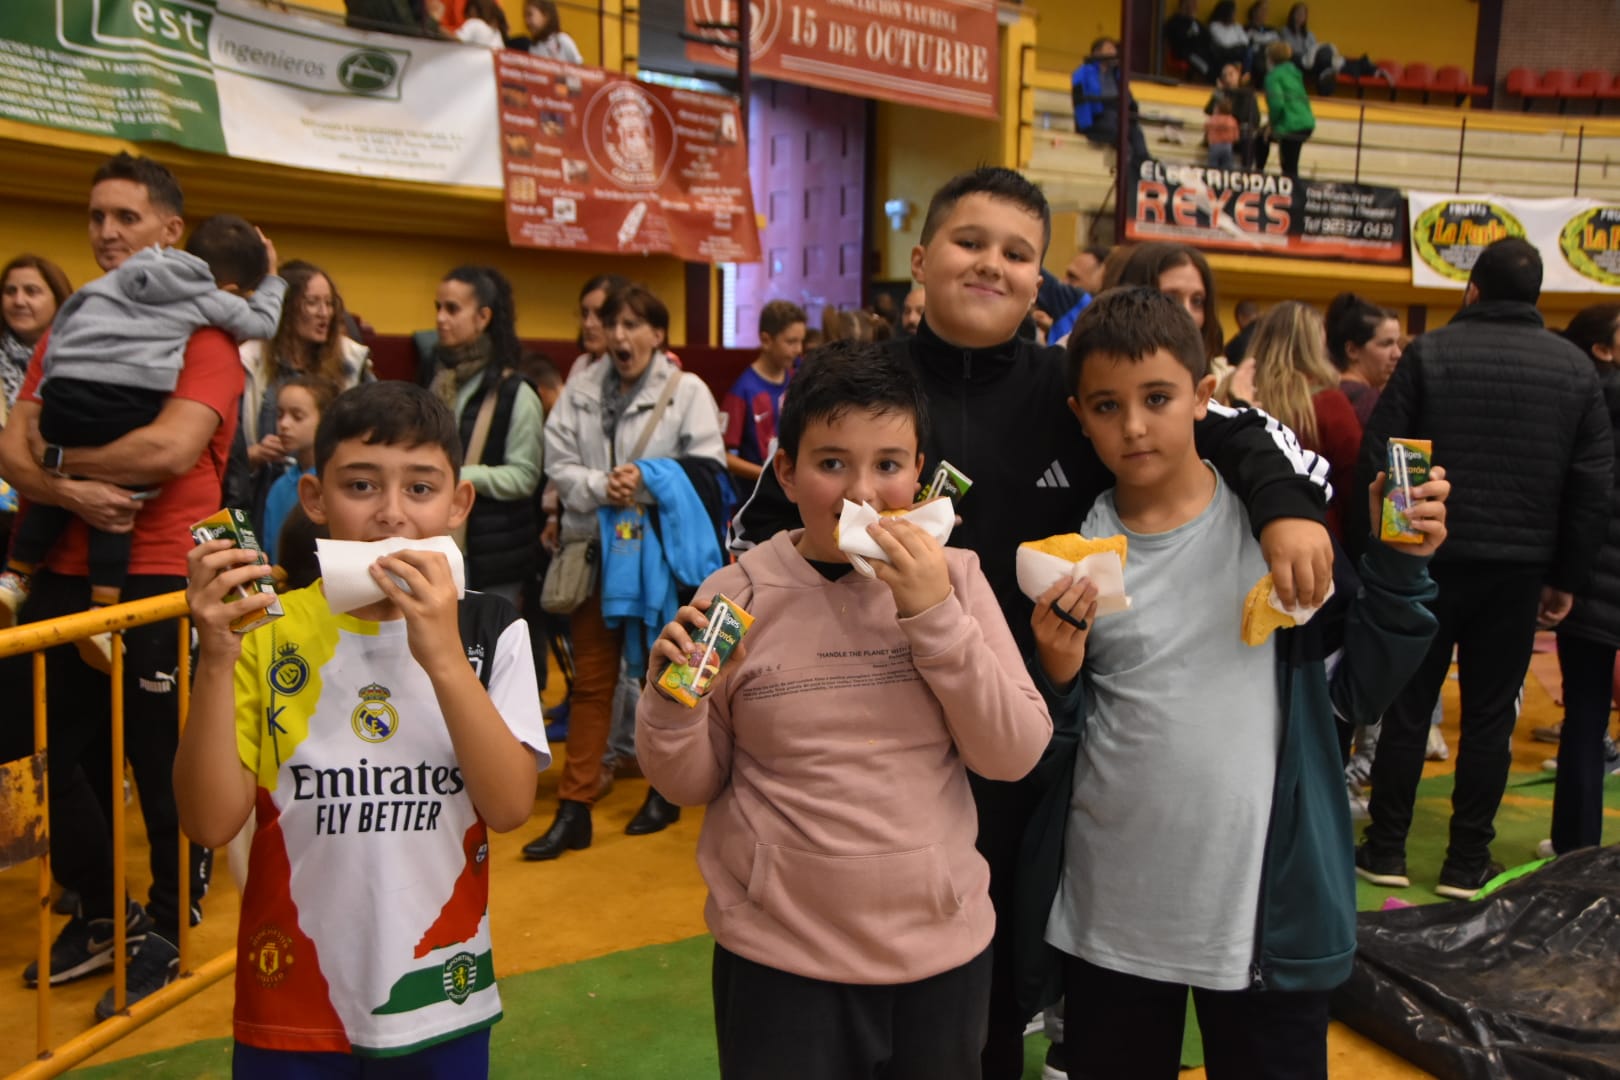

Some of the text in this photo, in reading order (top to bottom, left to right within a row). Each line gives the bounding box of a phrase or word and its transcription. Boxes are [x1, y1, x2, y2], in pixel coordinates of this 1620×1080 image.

[132, 1, 204, 50] est
[791, 6, 818, 47] 15
[829, 21, 858, 57] DE
[866, 22, 988, 83] OCTUBRE
[217, 33, 325, 79] ingenieros
[1140, 160, 1293, 196] ELETRICIDAD
[1136, 180, 1292, 236] REYES
[1432, 216, 1458, 246] La
[1583, 223, 1608, 250] La
[863, 648, 889, 657] PLANET
[289, 758, 465, 801] Emirates
[316, 800, 442, 836] FLY BETTER
